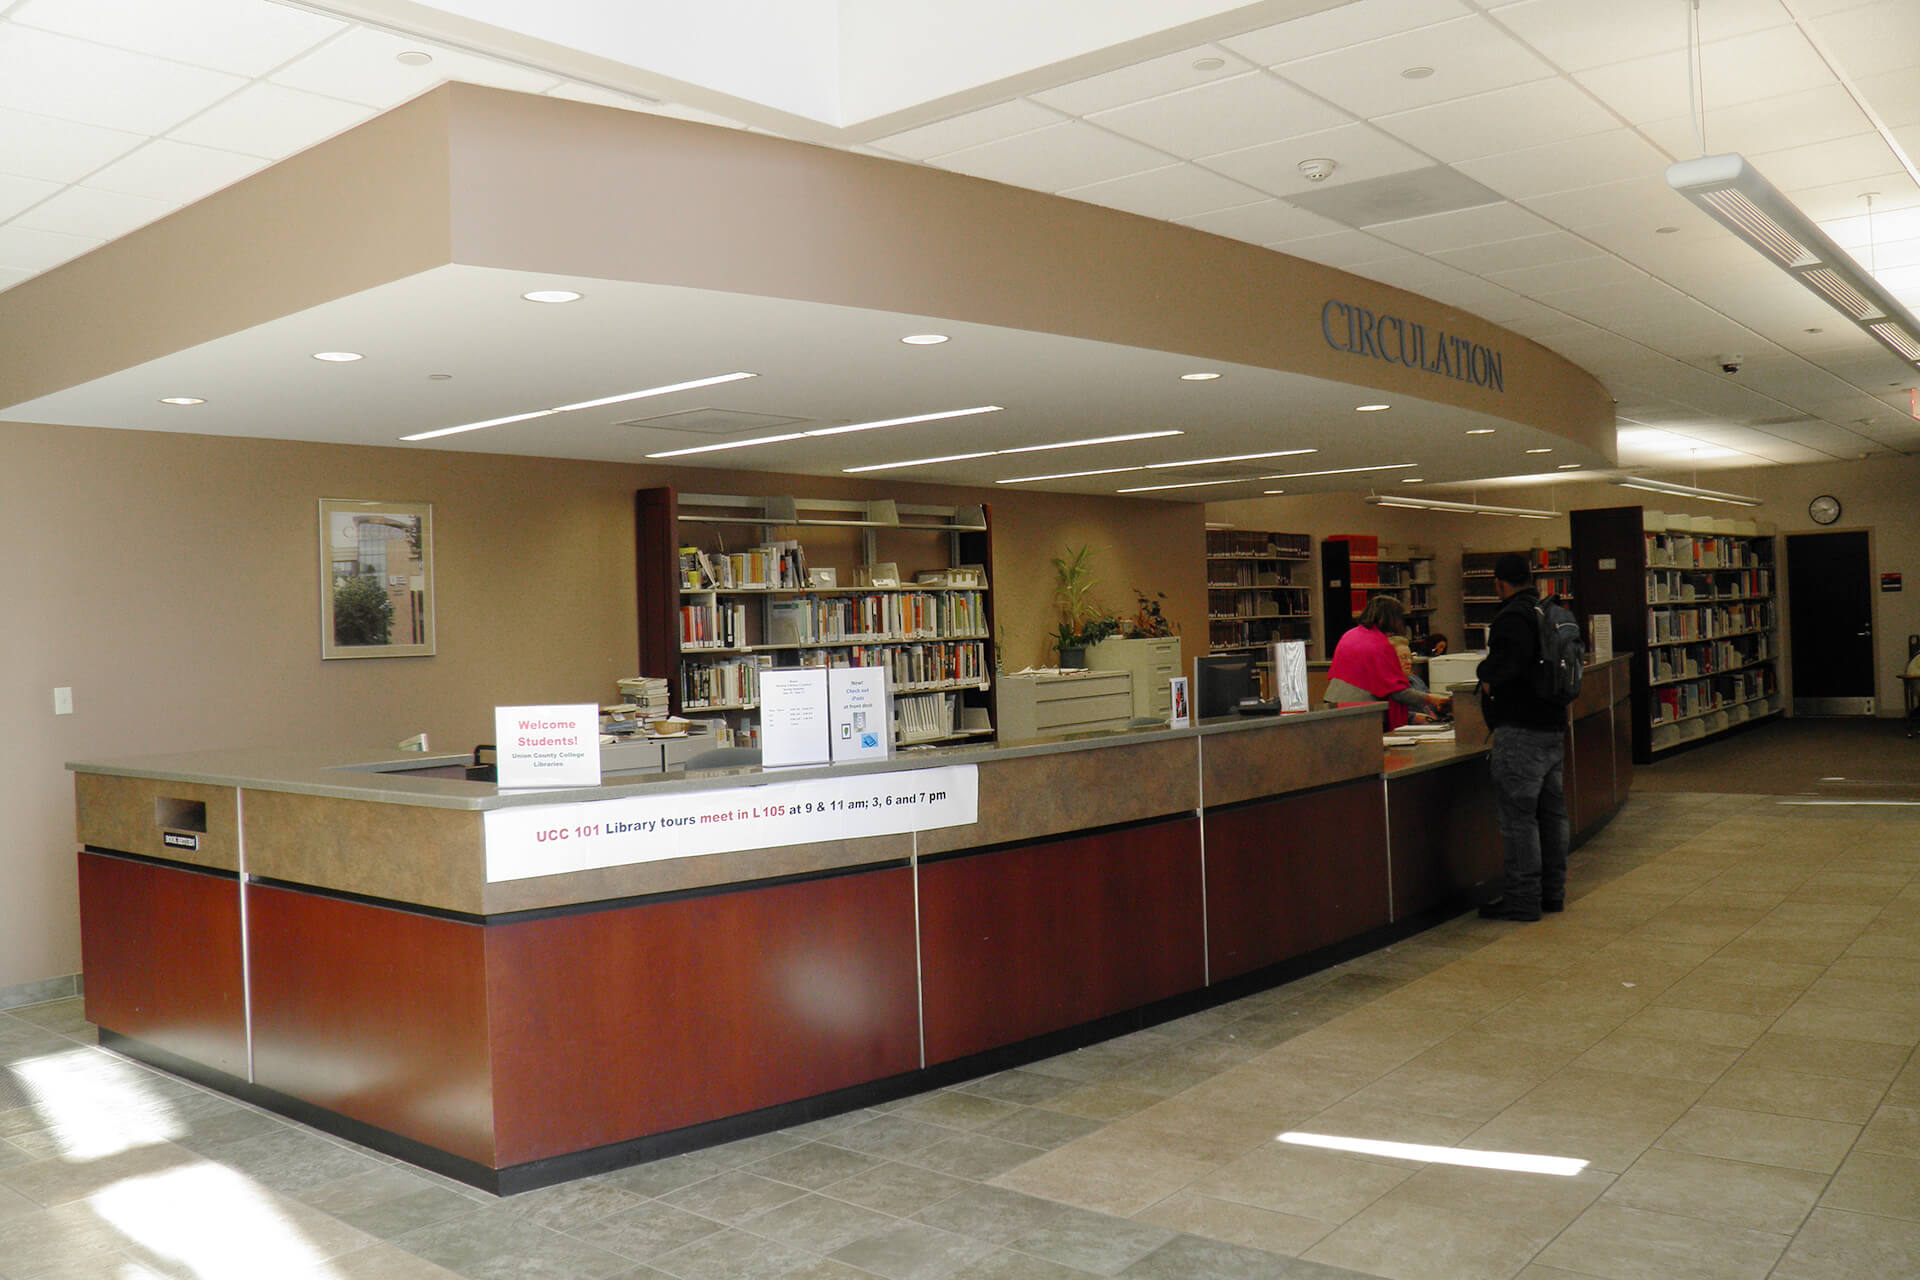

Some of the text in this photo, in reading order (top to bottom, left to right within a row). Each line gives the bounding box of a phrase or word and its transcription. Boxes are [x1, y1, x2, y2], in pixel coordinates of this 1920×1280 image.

[1322, 300, 1504, 393] CIRCULATION
[518, 720, 576, 730] Welcome
[518, 736, 578, 746] Students!
[533, 752, 557, 760] County
[536, 828, 569, 842] UCC
[575, 824, 600, 838] 101
[605, 819, 656, 835] Library
[660, 815, 697, 828] tours
[699, 810, 734, 824] meet
[737, 808, 749, 821] in
[789, 803, 801, 815] at
[805, 802, 813, 814] 9
[816, 802, 826, 812] &
[830, 799, 844, 811] 11
[848, 800, 869, 810] am;
[872, 796, 882, 808] 3,
[886, 795, 893, 805] 6
[895, 793, 916, 805] and
[919, 792, 926, 803] 7
[929, 790, 947, 803] pm
